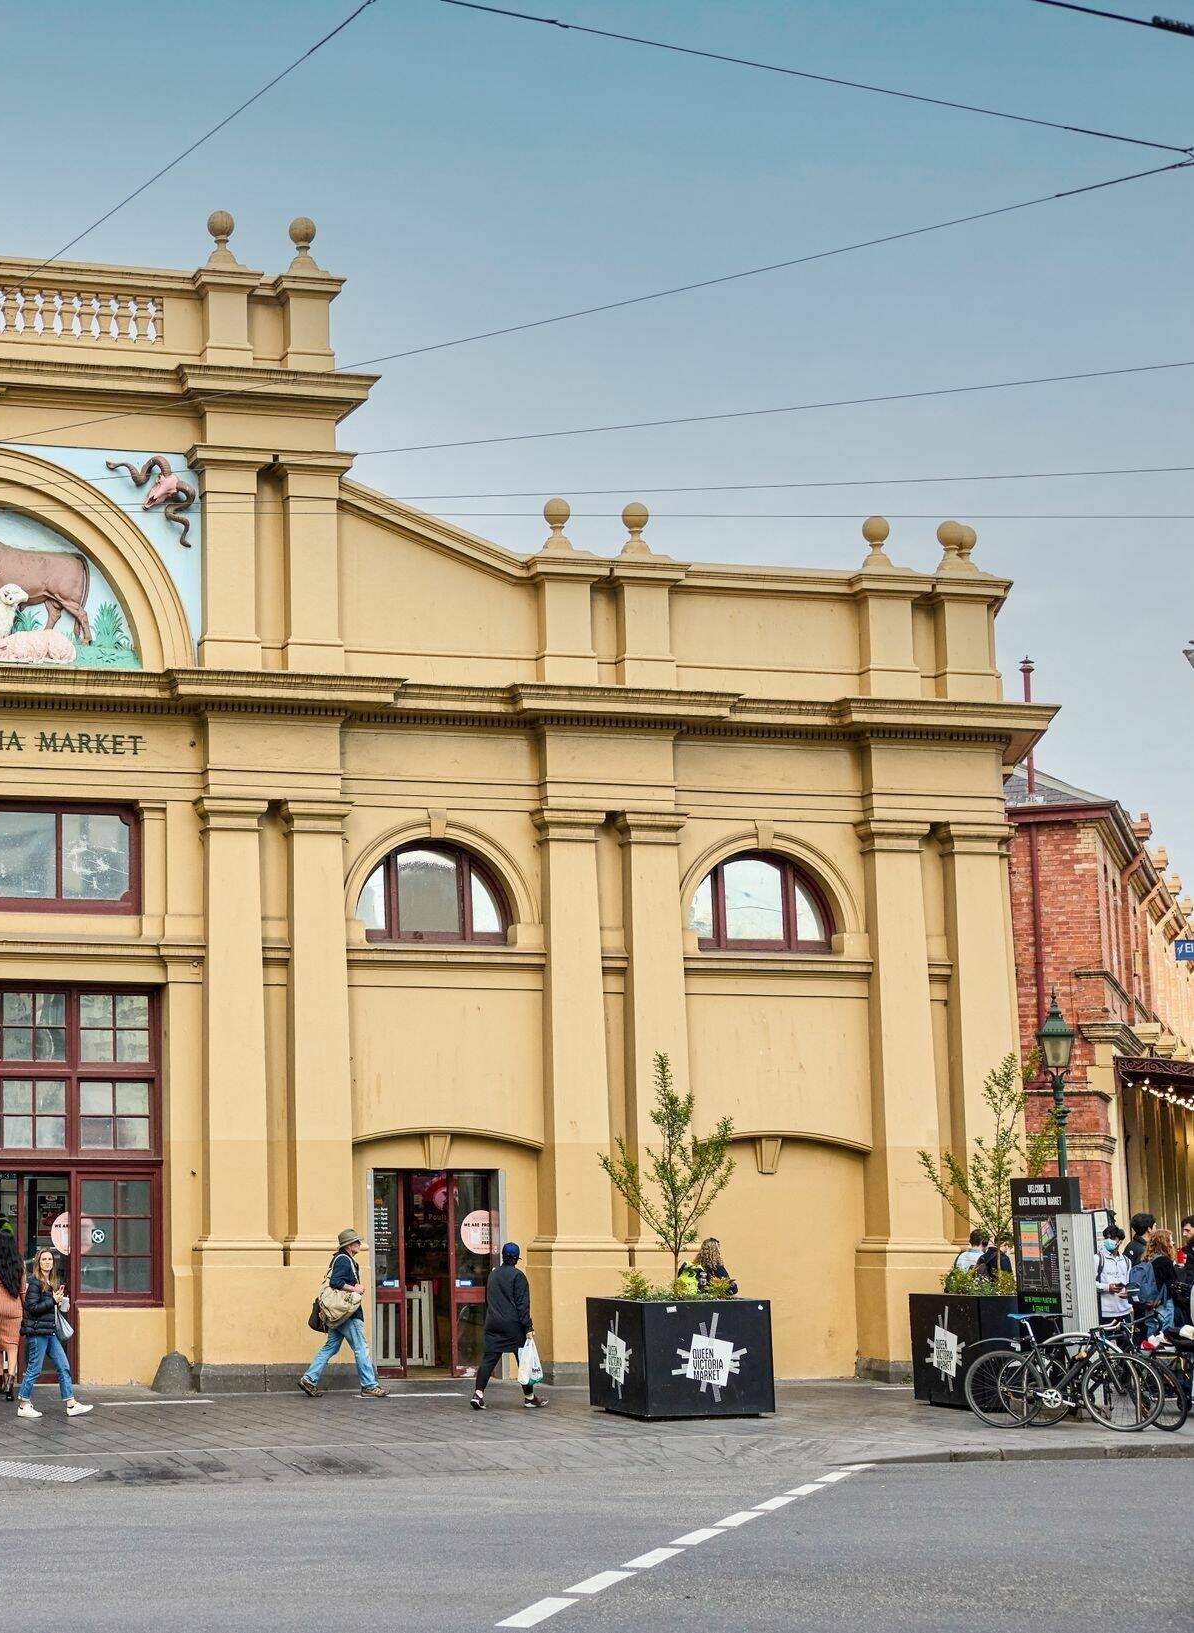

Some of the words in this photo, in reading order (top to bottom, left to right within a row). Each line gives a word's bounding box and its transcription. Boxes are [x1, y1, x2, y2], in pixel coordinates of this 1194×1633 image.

[39, 731, 143, 755] MARKET
[1062, 1228, 1069, 1242] ST
[1063, 1248, 1074, 1319] ELIZABETH
[693, 1349, 714, 1359] QUEEN
[693, 1359, 723, 1369] VICTORIA
[694, 1370, 720, 1380] MARKET
